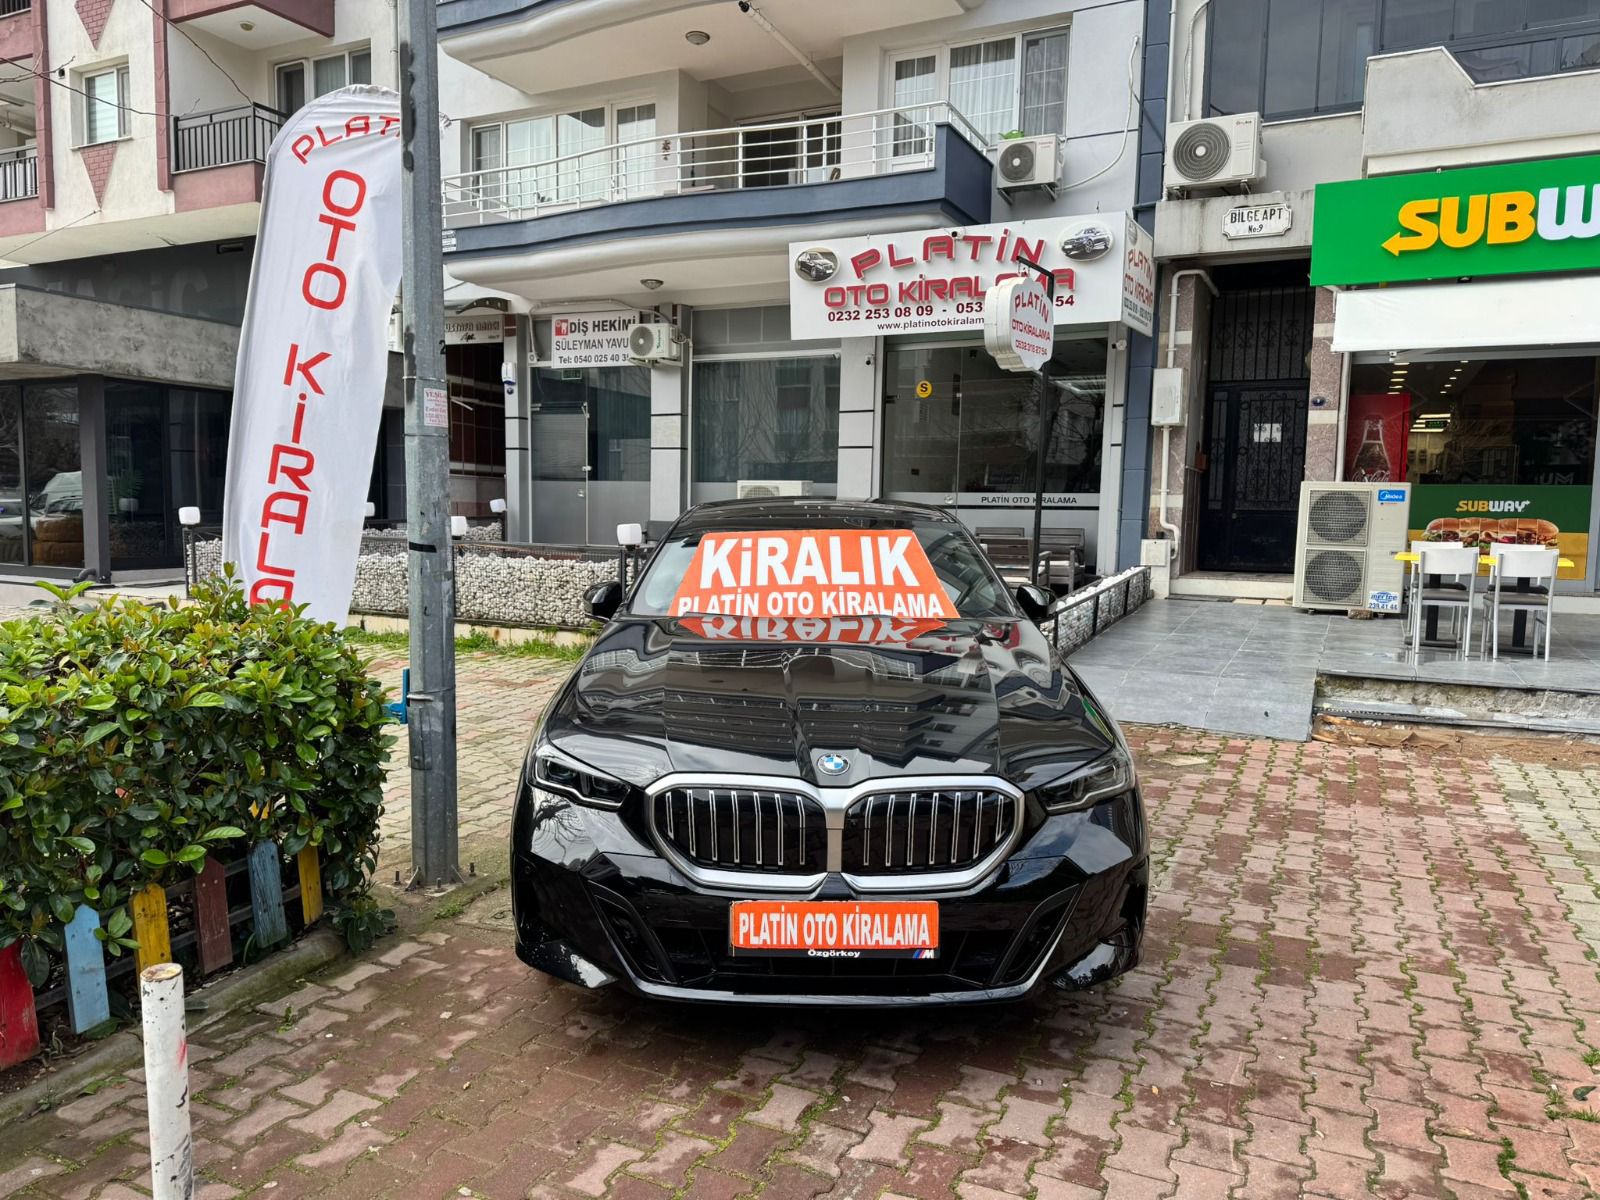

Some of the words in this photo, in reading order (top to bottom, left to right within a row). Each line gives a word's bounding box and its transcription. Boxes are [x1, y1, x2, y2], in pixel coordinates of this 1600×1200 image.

[291, 115, 400, 165] PLAT
[1230, 209, 1260, 224] BİLGE
[1262, 207, 1283, 221] APT
[1381, 183, 1600, 257] SUBW
[301, 168, 366, 311] OTO
[850, 228, 1046, 280] PLATİN
[824, 283, 891, 307] OTO
[1014, 290, 1050, 323] PLATİN
[828, 310, 861, 322] 0232
[865, 308, 890, 320] 253
[895, 306, 912, 318] 08
[916, 305, 933, 316] 09
[1055, 295, 1075, 307] 54
[569, 318, 589, 337] DİŞ
[555, 337, 604, 351] SÜLEYMAN
[558, 355, 572, 364] Tel:
[574, 355, 592, 364] 0540
[594, 354, 608, 363] 025
[610, 353, 619, 362] 40
[920, 382, 928, 393] S
[981, 494, 1010, 504] PLATİN
[1012, 496, 1030, 504] OTO
[1032, 496, 1077, 504] KRALAMA
[1456, 499, 1531, 513] SUBWAY
[678, 588, 760, 617] PLATİN
[766, 590, 815, 616] OTO
[821, 585, 945, 618] KİRALAMA
[738, 904, 798, 945] PLATİN
[803, 912, 838, 945] OTO
[842, 904, 930, 946] KİRALAMA
[807, 948, 861, 958] Özgörkey
